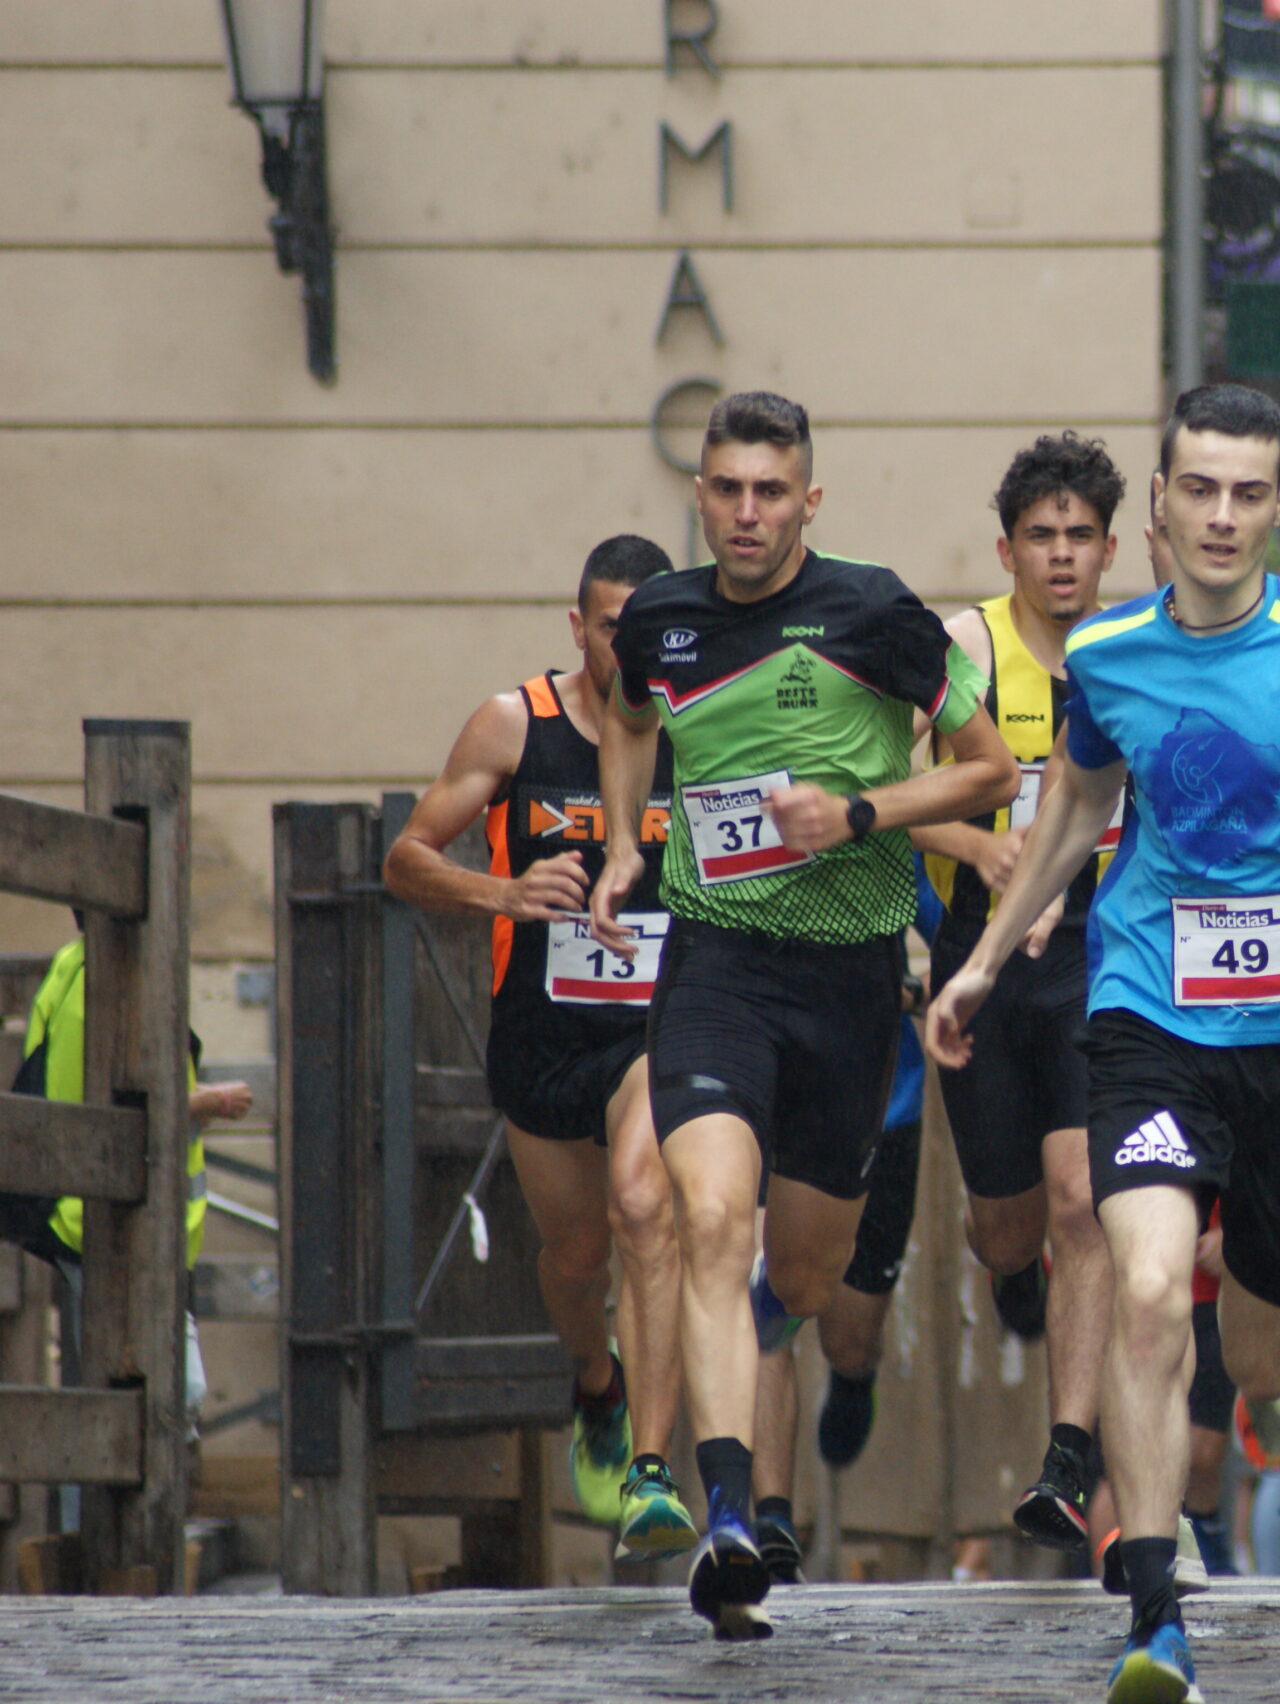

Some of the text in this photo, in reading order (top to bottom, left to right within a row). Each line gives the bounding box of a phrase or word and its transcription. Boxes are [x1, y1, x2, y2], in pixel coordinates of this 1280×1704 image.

[702, 792, 760, 813] Noticias
[717, 815, 763, 852] 37
[1202, 912, 1269, 928] Noticias
[586, 949, 635, 979] 13
[1212, 938, 1269, 974] 49
